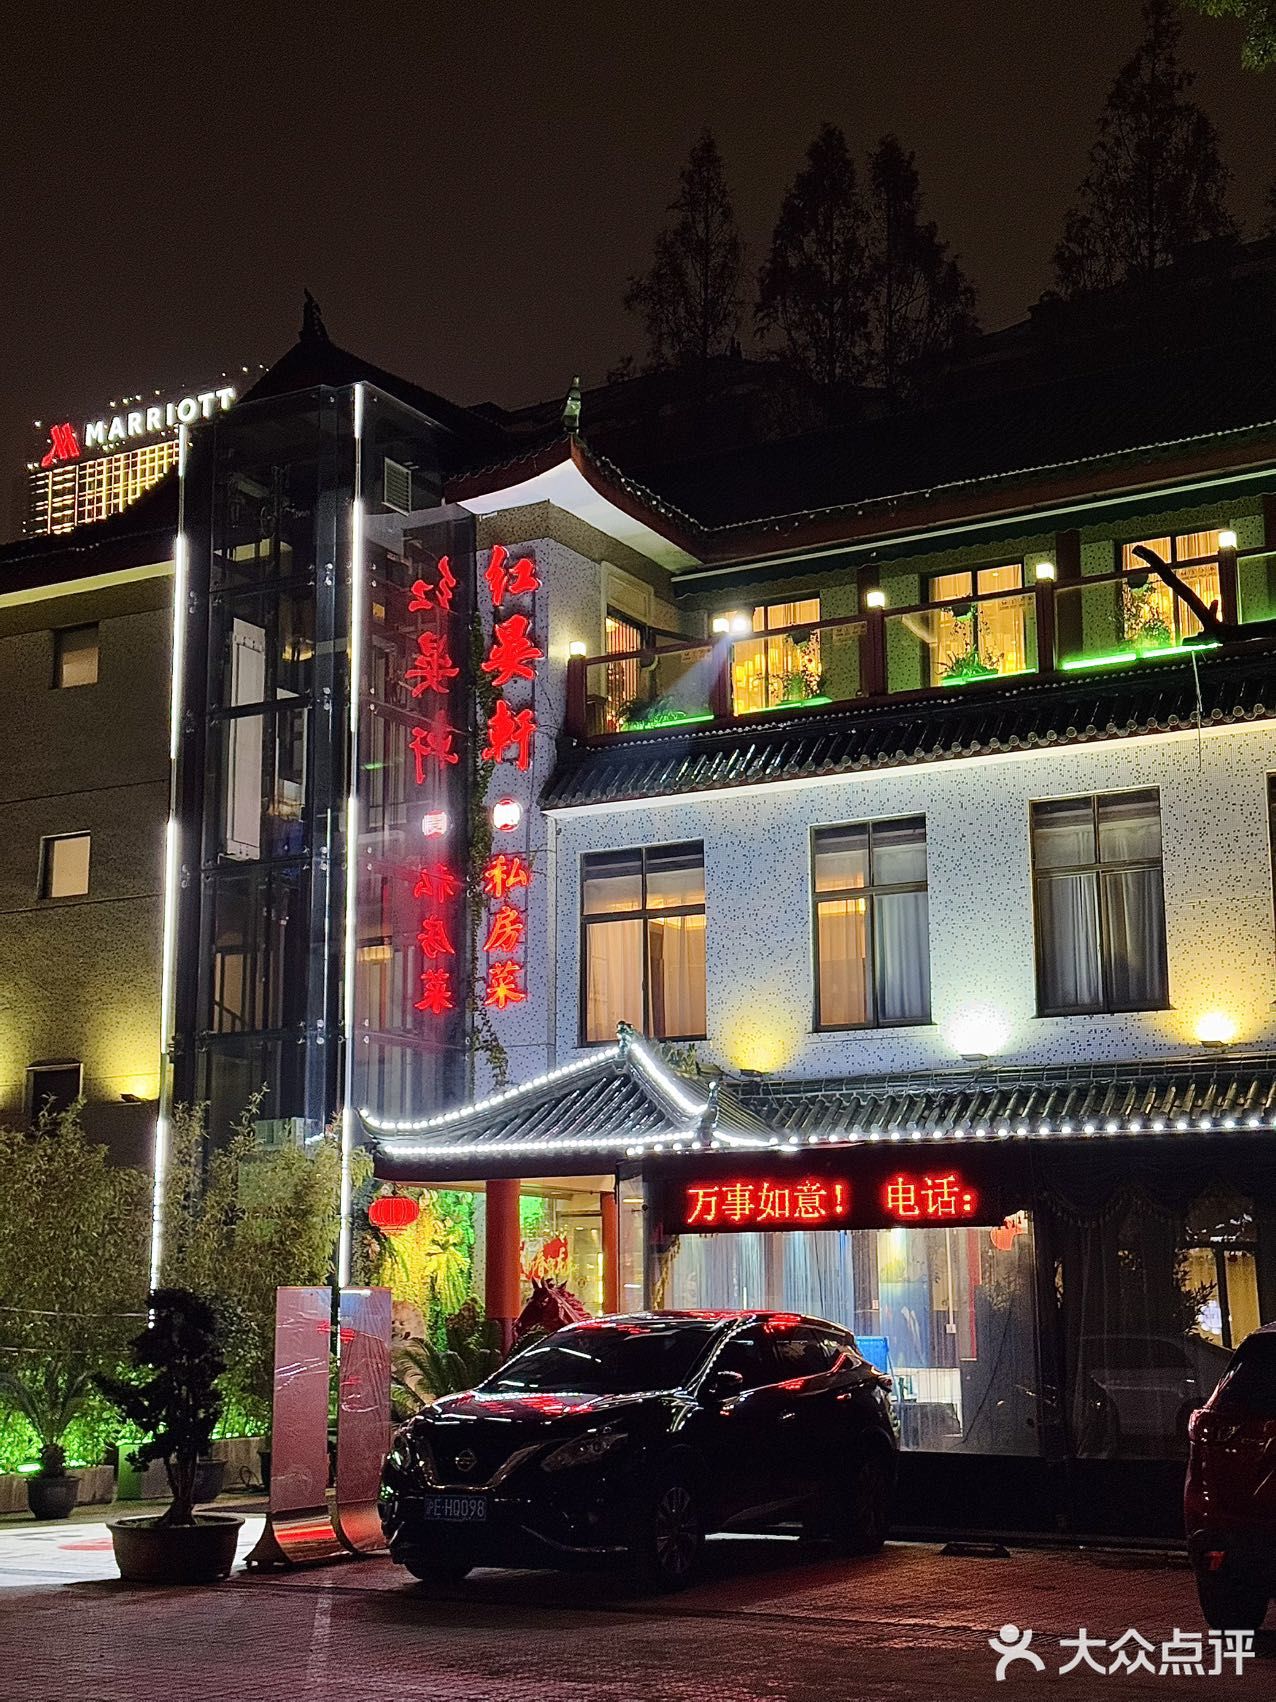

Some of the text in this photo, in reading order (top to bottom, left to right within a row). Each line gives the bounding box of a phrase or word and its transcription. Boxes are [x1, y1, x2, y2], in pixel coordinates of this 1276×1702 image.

[84, 387, 236, 446] MARRIOTT
[483, 854, 530, 1010] 私房菜
[687, 1174, 971, 1224] 万事如意! 电话:
